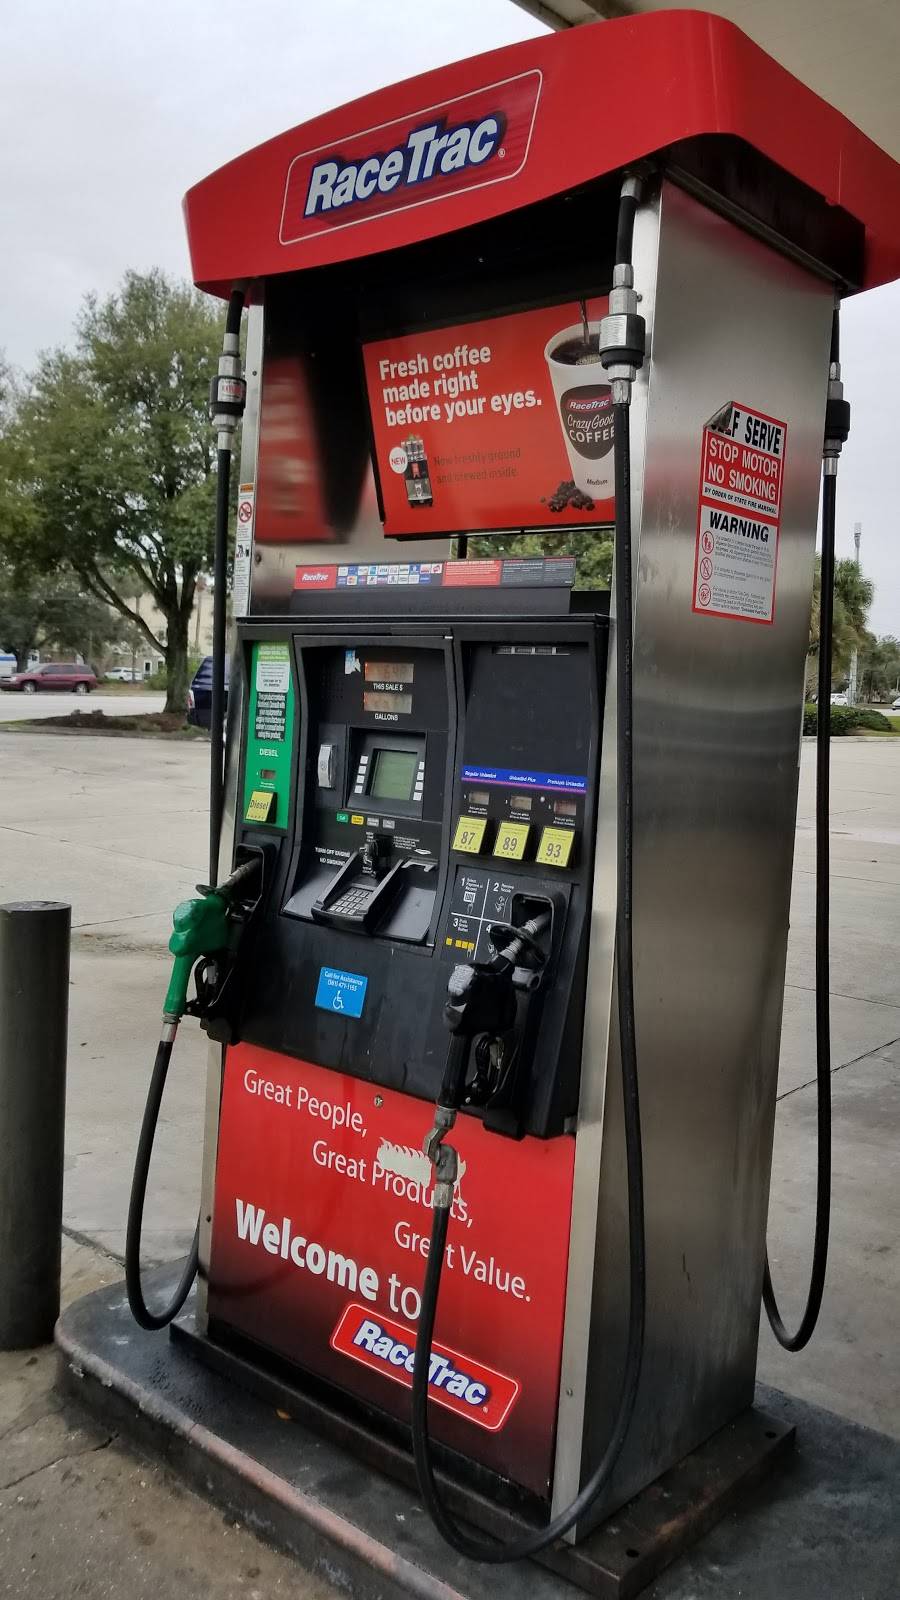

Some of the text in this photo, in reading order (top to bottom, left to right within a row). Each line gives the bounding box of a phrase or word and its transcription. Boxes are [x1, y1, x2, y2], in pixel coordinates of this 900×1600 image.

[304, 117, 499, 217] RaceTrac
[379, 344, 491, 381] Fresh coffee
[383, 370, 479, 404] made right
[385, 389, 542, 427] before your eyes.
[569, 399, 610, 410] RaceTrac
[567, 414, 592, 432] Crazy
[569, 425, 615, 443] COFFEE
[744, 415, 782, 455] SERVE
[391, 456, 407, 467] NEW
[709, 437, 779, 479] STOP MOTOR
[708, 460, 776, 502] NO SMOKING
[711, 488, 727, 499] ORDER
[734, 496, 747, 506] STATE
[747, 500, 757, 509] FIRE
[757, 503, 777, 515] MARSHAL
[709, 511, 769, 543] WARNING
[301, 573, 328, 583] RaceTrac
[385, 683, 399, 691] SALE
[374, 713, 399, 721] GALLONS
[259, 748, 279, 757] DIESEL
[464, 770, 480, 778] Regular
[249, 800, 270, 810] Diesel
[460, 831, 476, 846] 87
[502, 836, 518, 852] 89
[545, 842, 562, 858] 93
[461, 877, 466, 887] 1
[492, 882, 500, 892] 2
[452, 917, 459, 928] 3
[485, 923, 492, 934] 4
[243, 1069, 368, 1138] Great People,
[312, 1139, 474, 1228] Great Produts,
[235, 1198, 422, 1320] Welcome to
[394, 1220, 532, 1303] Gret Value.
